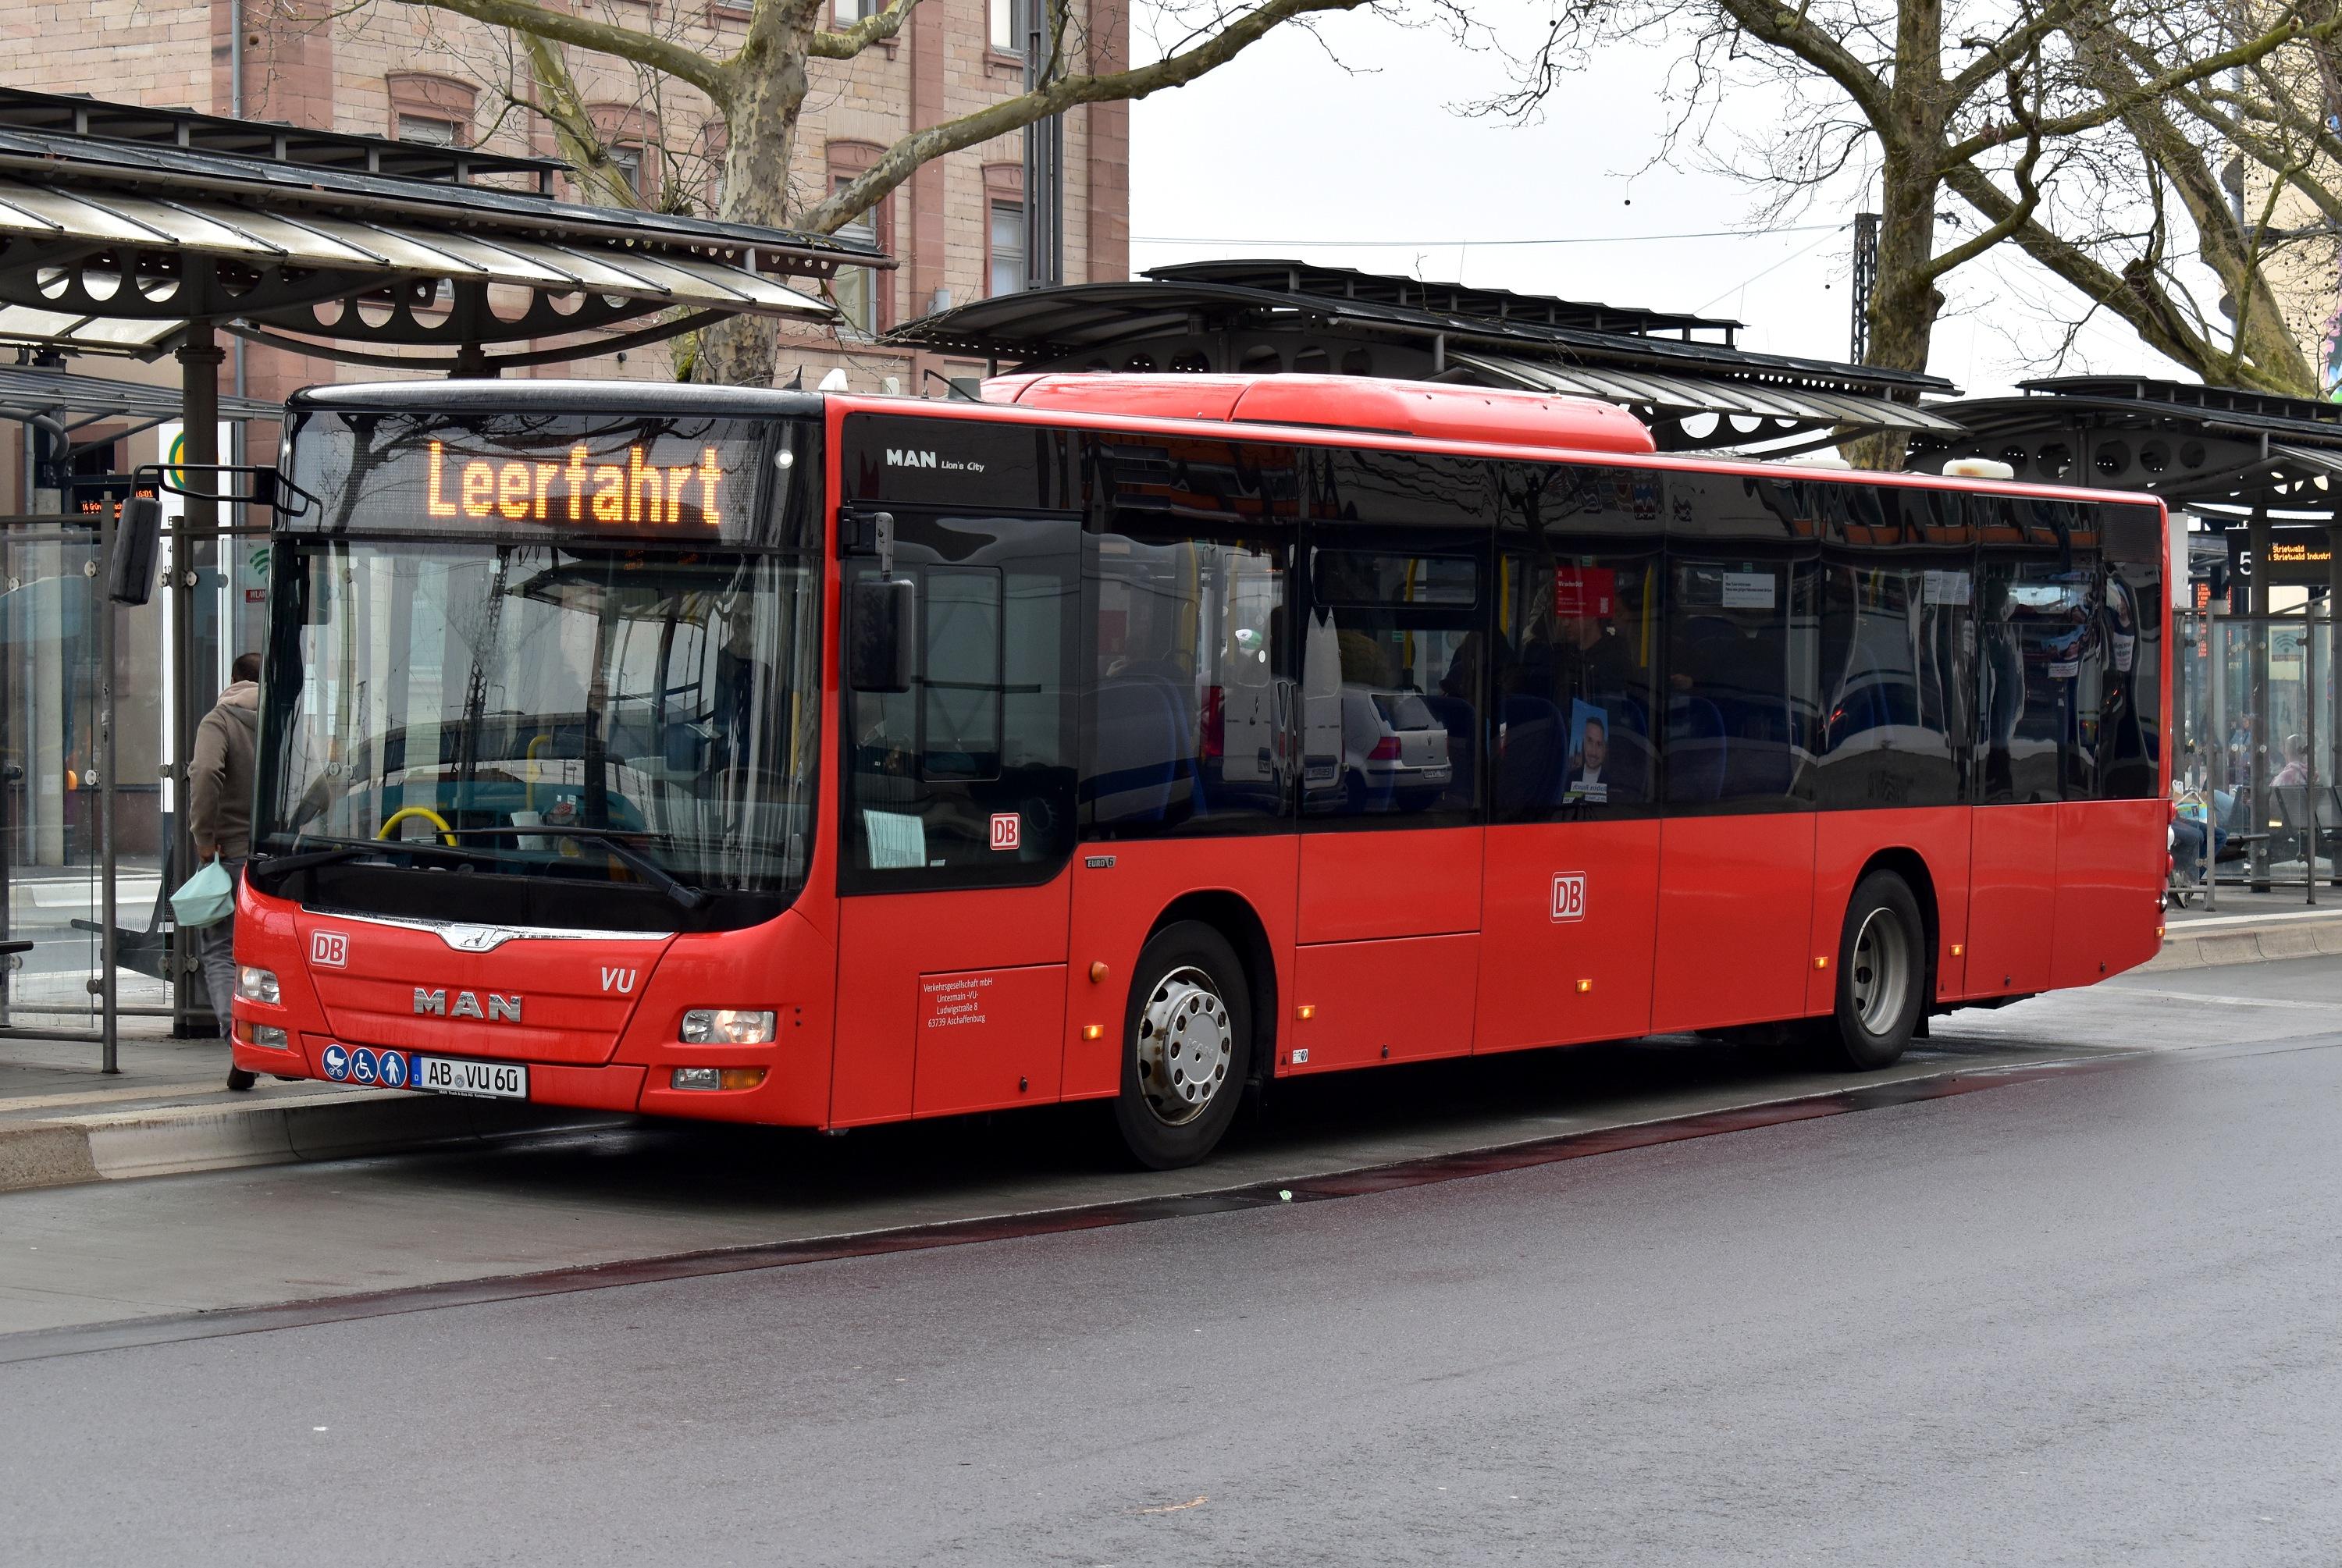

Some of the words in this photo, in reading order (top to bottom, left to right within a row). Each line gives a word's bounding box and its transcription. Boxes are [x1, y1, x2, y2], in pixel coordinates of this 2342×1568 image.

[886, 448, 937, 468] MAN
[941, 460, 964, 470] Lion's
[966, 461, 985, 473] City
[428, 441, 721, 524] Leerfahrt
[2239, 551, 2251, 576] 5
[2273, 553, 2305, 561] Strietwald
[994, 820, 1016, 844] DB
[1087, 859, 1105, 868] EURO
[1555, 880, 1582, 914] DB
[315, 936, 343, 962] DB
[600, 966, 636, 994] VU
[924, 978, 979, 993] Verkehrsgesellschaft
[979, 977, 993, 987] mbH
[413, 987, 522, 1022] MAN
[936, 1003, 973, 1015] Ludwigstraße
[973, 1002, 978, 1011] 8
[937, 992, 966, 1003] Untermain
[966, 990, 979, 1000] -VU-
[927, 1017, 946, 1028] 63739
[946, 1015, 986, 1026] Aschaffenburg
[429, 1061, 452, 1086] AB
[464, 1065, 489, 1090] VU
[494, 1068, 518, 1092] 60
